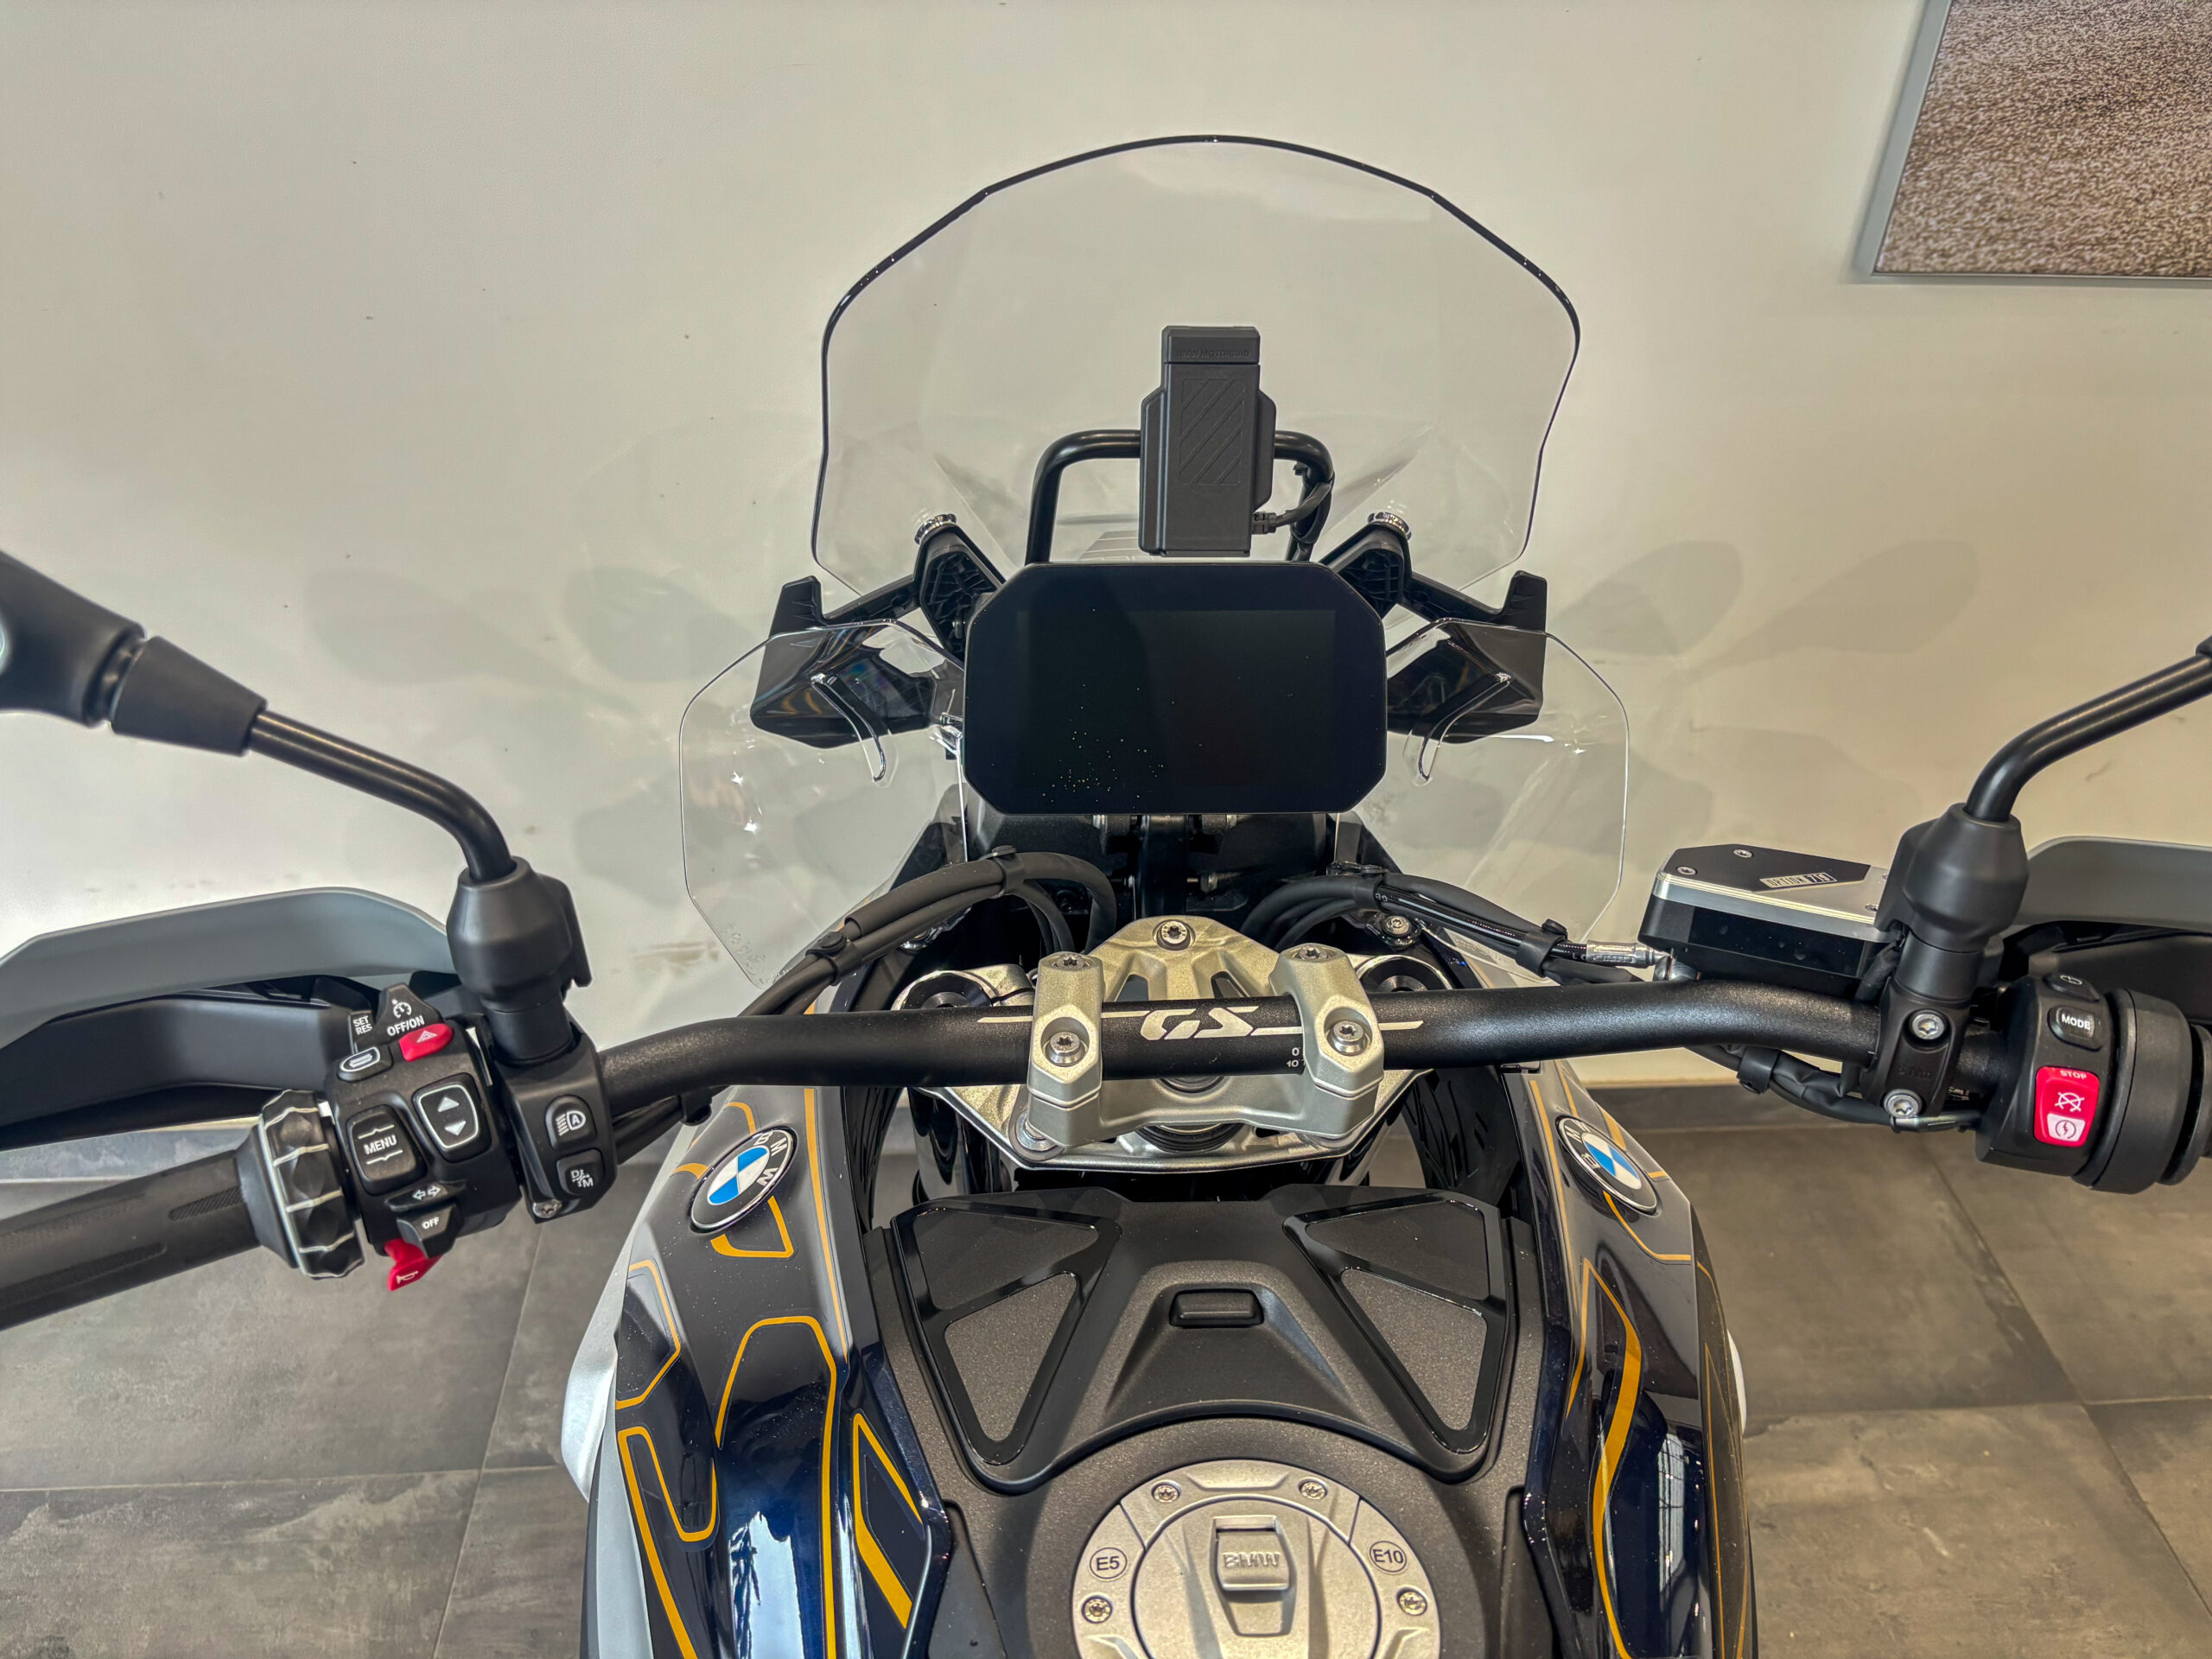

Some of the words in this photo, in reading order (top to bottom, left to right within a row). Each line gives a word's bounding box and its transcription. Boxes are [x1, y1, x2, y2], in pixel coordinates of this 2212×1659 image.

[1767, 875, 1807, 887] OPTION
[1806, 874, 1832, 883] 719
[353, 1015, 369, 1027] SET
[387, 1014, 425, 1037] OFF/ON
[1140, 1006, 1259, 1040] GS
[2061, 1014, 2091, 1031] MODE
[355, 1023, 373, 1036] RES
[2059, 1070, 2088, 1080] STOP
[571, 1114, 581, 1126] A
[364, 1134, 398, 1155] MENU
[753, 1130, 788, 1187] BMW
[421, 1217, 440, 1230] OFF
[1096, 1555, 1121, 1572] E5
[1222, 1551, 1281, 1569] BMW
[1372, 1549, 1404, 1565] E10
